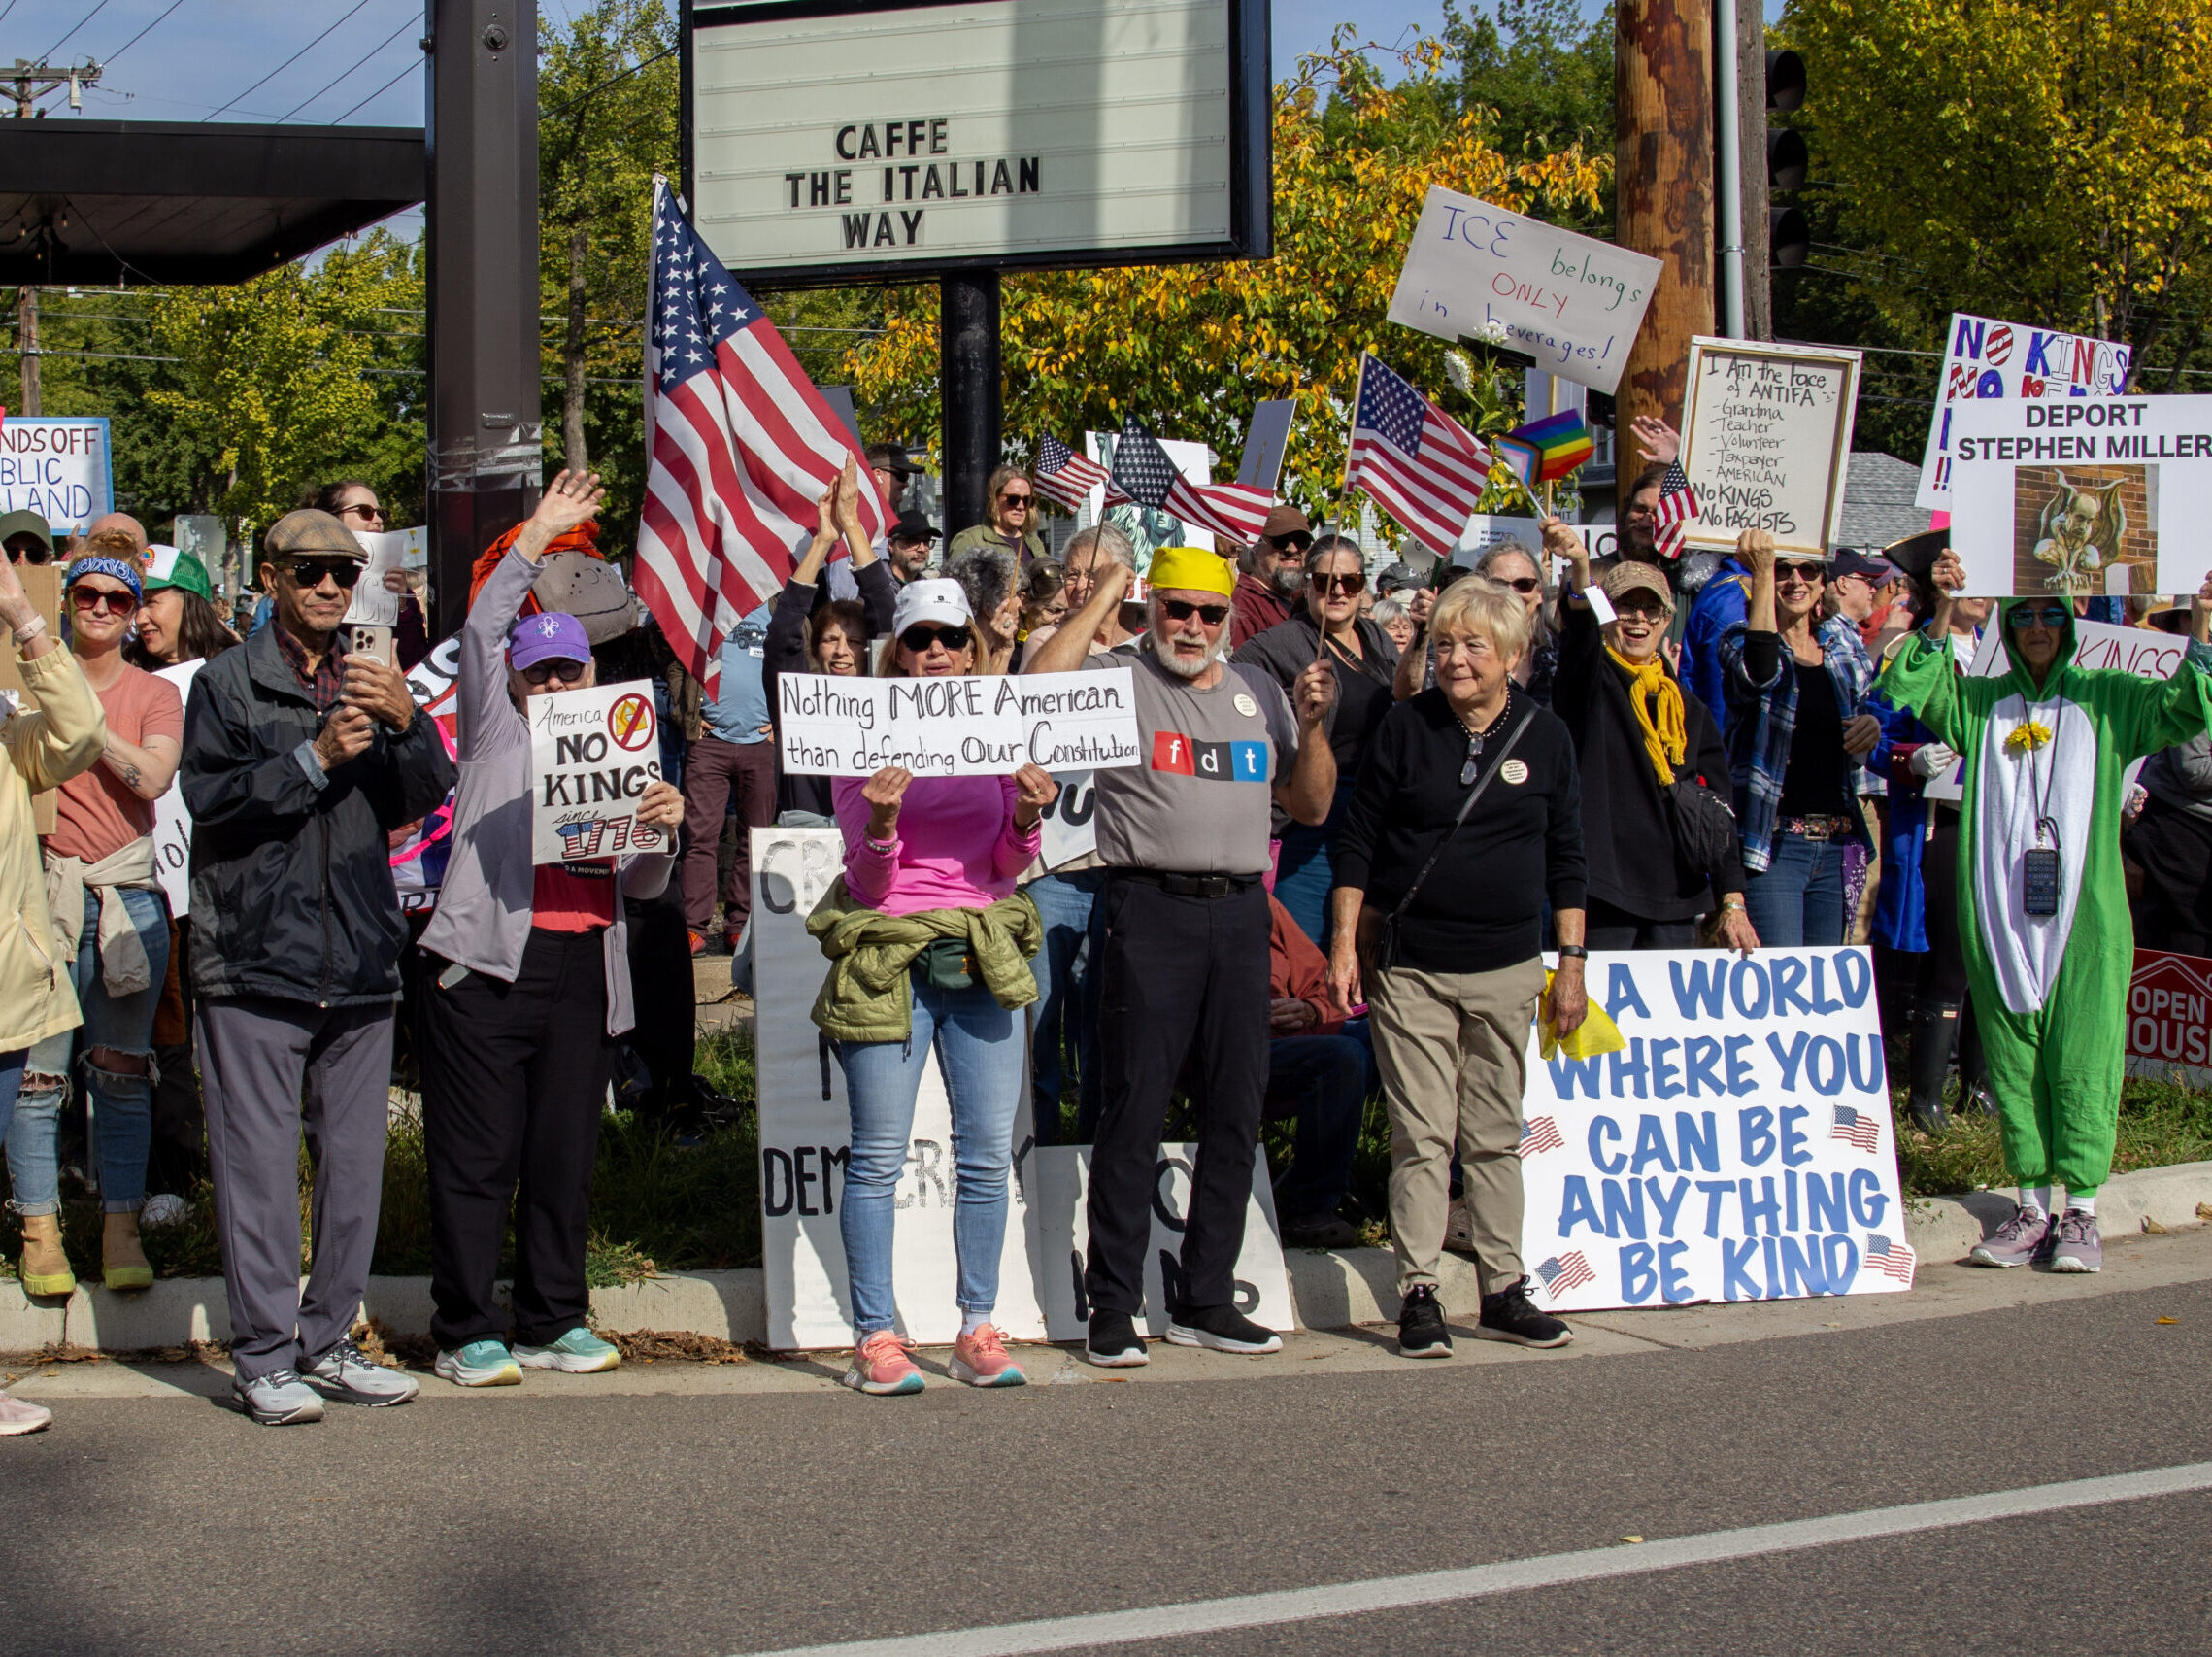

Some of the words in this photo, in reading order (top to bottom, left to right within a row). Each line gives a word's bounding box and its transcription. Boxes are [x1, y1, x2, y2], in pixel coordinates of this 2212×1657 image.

[836, 118, 948, 160] CAFFE
[785, 169, 852, 208] THE
[884, 156, 1039, 202] ITALIAN
[841, 209, 924, 249] WAY
[1443, 205, 1516, 258] ICE
[1550, 247, 1642, 311] belongs
[1419, 290, 1448, 318] in
[1491, 272, 1568, 319] ONLY
[1705, 354, 1719, 376] I
[1726, 355, 1752, 380] Am
[1758, 359, 1783, 384] the
[1954, 318, 2014, 367] NO
[2025, 331, 2128, 395] KINGS
[1726, 375, 1743, 398] of
[1749, 381, 1816, 407] ANTIFA
[1947, 362, 2004, 403] NO
[2026, 403, 2148, 428] DEPORT
[51, 427, 100, 455] OFF
[1957, 436, 2096, 461] STEPHEN
[2106, 434, 2212, 459] MILLER
[1, 457, 63, 486] BLIC
[1719, 483, 1773, 511] KINGS
[1725, 505, 1797, 535] FASCISTS
[536, 696, 605, 736] America
[782, 675, 875, 730] Nothing
[889, 678, 983, 721] MORE
[993, 678, 1124, 718] American
[556, 731, 608, 765] NO
[786, 736, 840, 769] than
[852, 730, 955, 776] defending
[960, 735, 1024, 764] Our
[1028, 720, 1140, 767] Constitution
[542, 761, 662, 808] KINGS
[552, 809, 606, 825] since
[555, 814, 662, 859] 1776
[1605, 962, 1652, 1024] A
[1668, 948, 1872, 1021] WORLD
[2131, 985, 2206, 1025] OPEN
[2125, 1013, 2212, 1065] OUS
[1547, 1033, 1760, 1101] WHERE
[1765, 1031, 1885, 1097] YOU
[1587, 1110, 1721, 1176] CAN
[1738, 1104, 1814, 1168] BE
[1557, 1167, 1890, 1240] ANYTHING
[1619, 1239, 1695, 1305] BE
[1722, 1233, 1860, 1302] KIND
